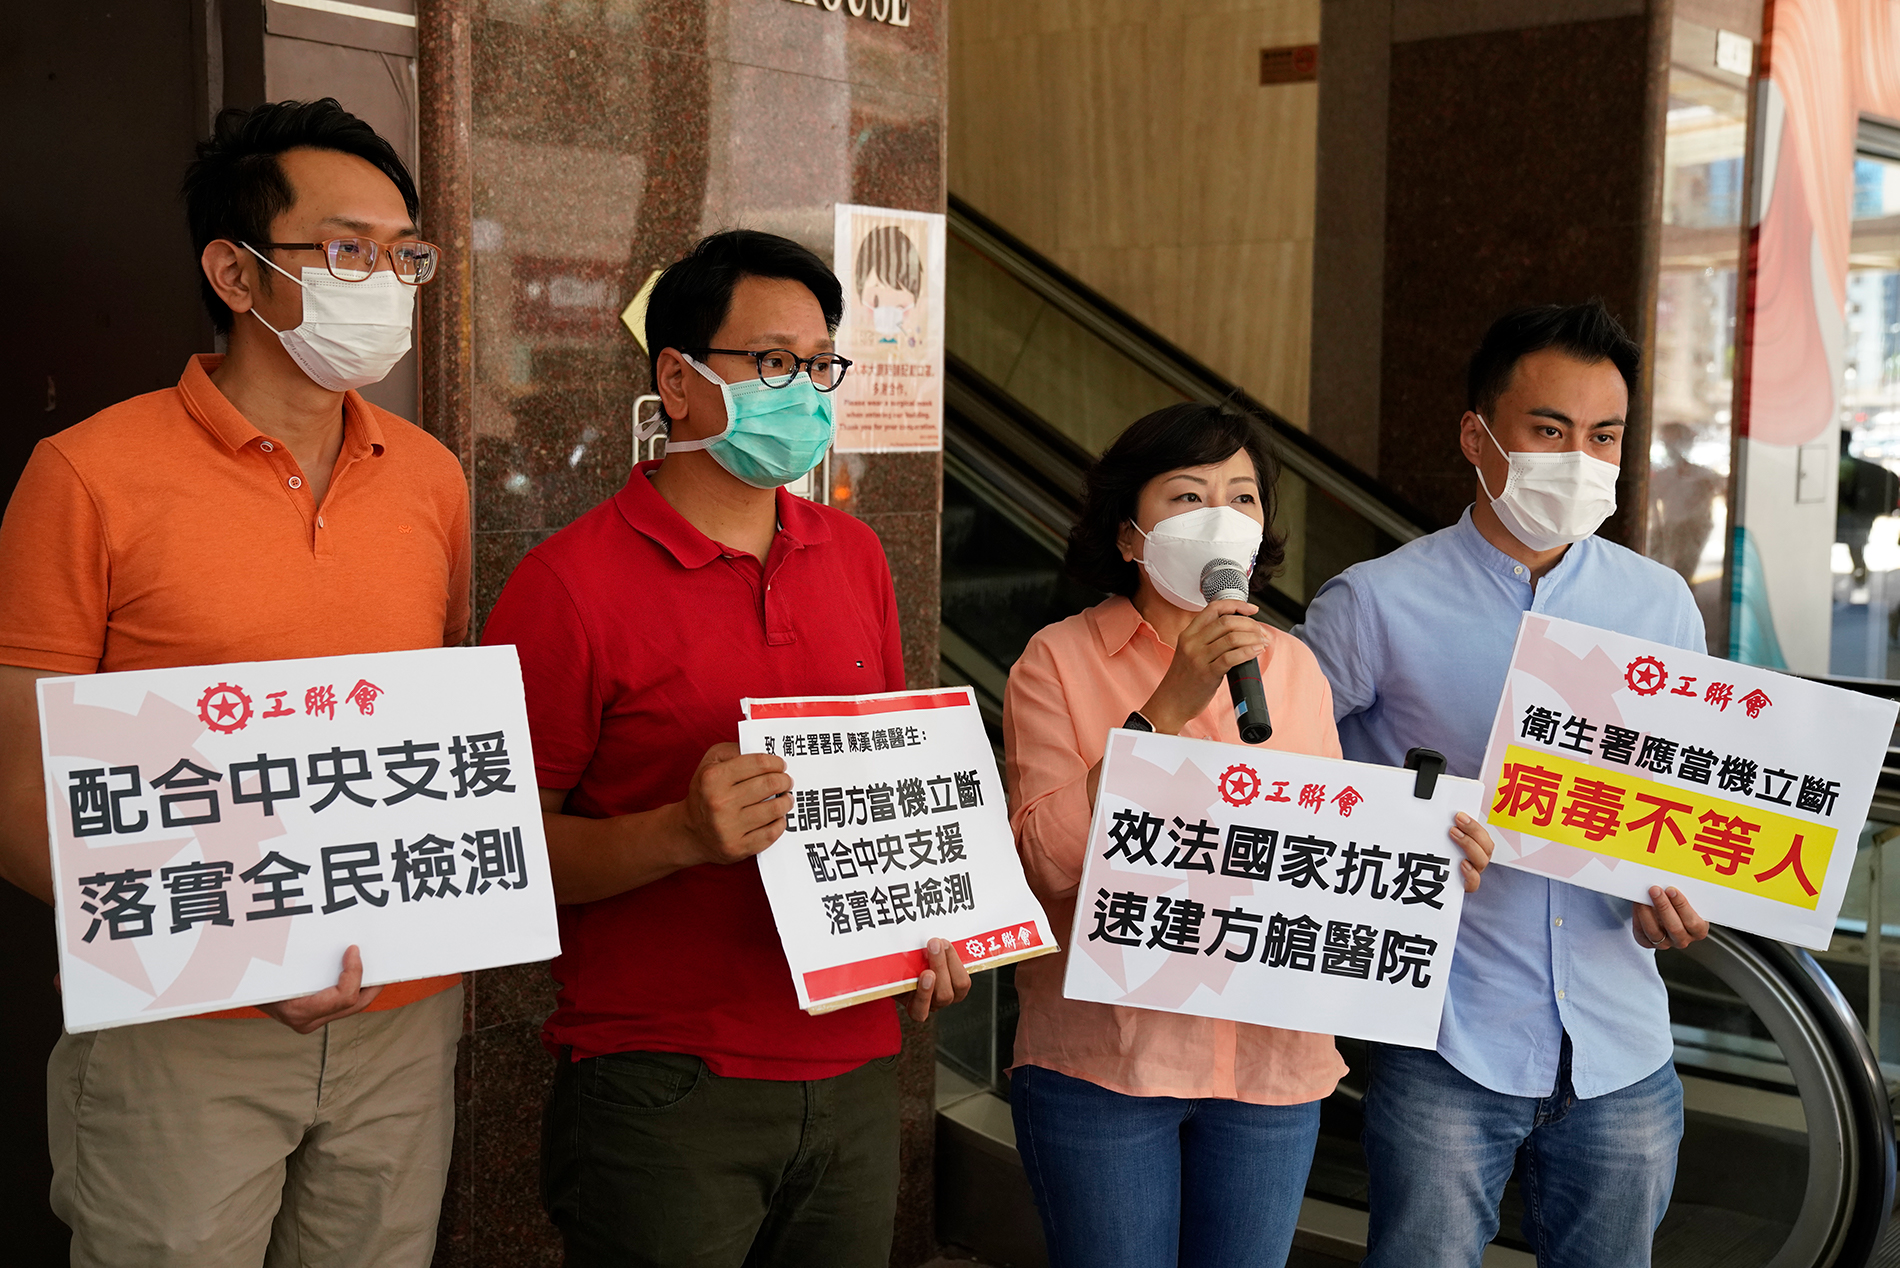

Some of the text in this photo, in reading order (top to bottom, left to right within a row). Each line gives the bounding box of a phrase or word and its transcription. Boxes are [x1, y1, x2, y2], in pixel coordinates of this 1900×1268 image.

[262, 679, 385, 721] 工聯會
[1670, 676, 1773, 719] 工聯會
[764, 726, 928, 757] 致 衛生署署長 陳漢儀醫生:
[1520, 704, 1841, 816] 衛生署應當機立斷
[68, 730, 518, 838] 配合中央支援
[1264, 781, 1364, 818] 工聯會
[804, 821, 967, 883] 配合中央支援
[1103, 808, 1451, 910] 效法國家抗疫
[1492, 763, 1819, 897] 病毒不等人
[78, 826, 530, 944] 落實全民檢測
[821, 871, 975, 936] 落實全民檢測
[988, 926, 1032, 952] 工聯會
[1087, 888, 1439, 989] 速建方艙醫院
